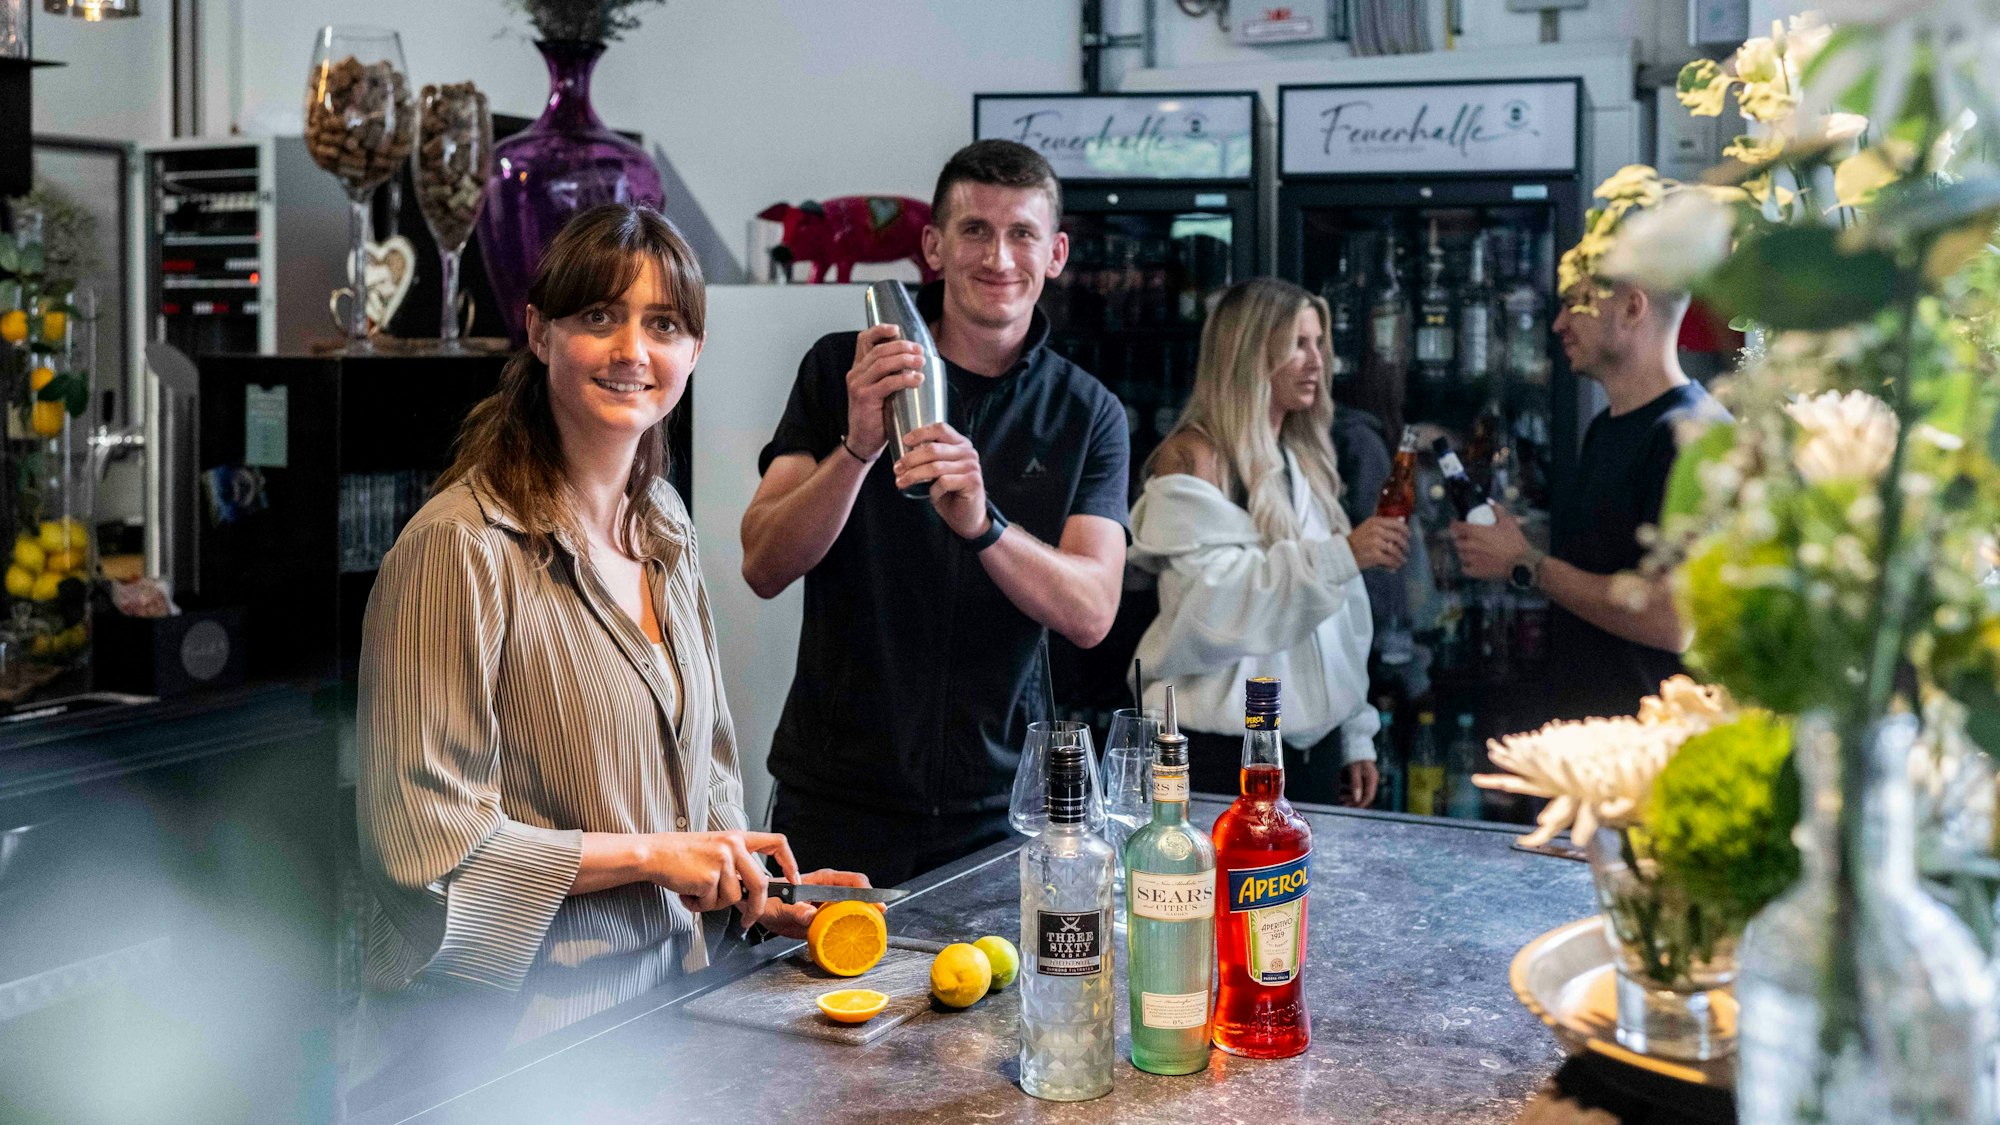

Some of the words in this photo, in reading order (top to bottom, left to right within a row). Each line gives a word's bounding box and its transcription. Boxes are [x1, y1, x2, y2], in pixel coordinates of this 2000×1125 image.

[1320, 101, 1540, 157] Feuerhalle
[1238, 866, 1309, 904] APEROL
[1137, 886, 1213, 903] SEARS
[1156, 904, 1198, 912] CITRUS
[1046, 931, 1094, 943] THREE
[1271, 931, 1285, 941] 1919
[1050, 942, 1091, 953] SIXTY
